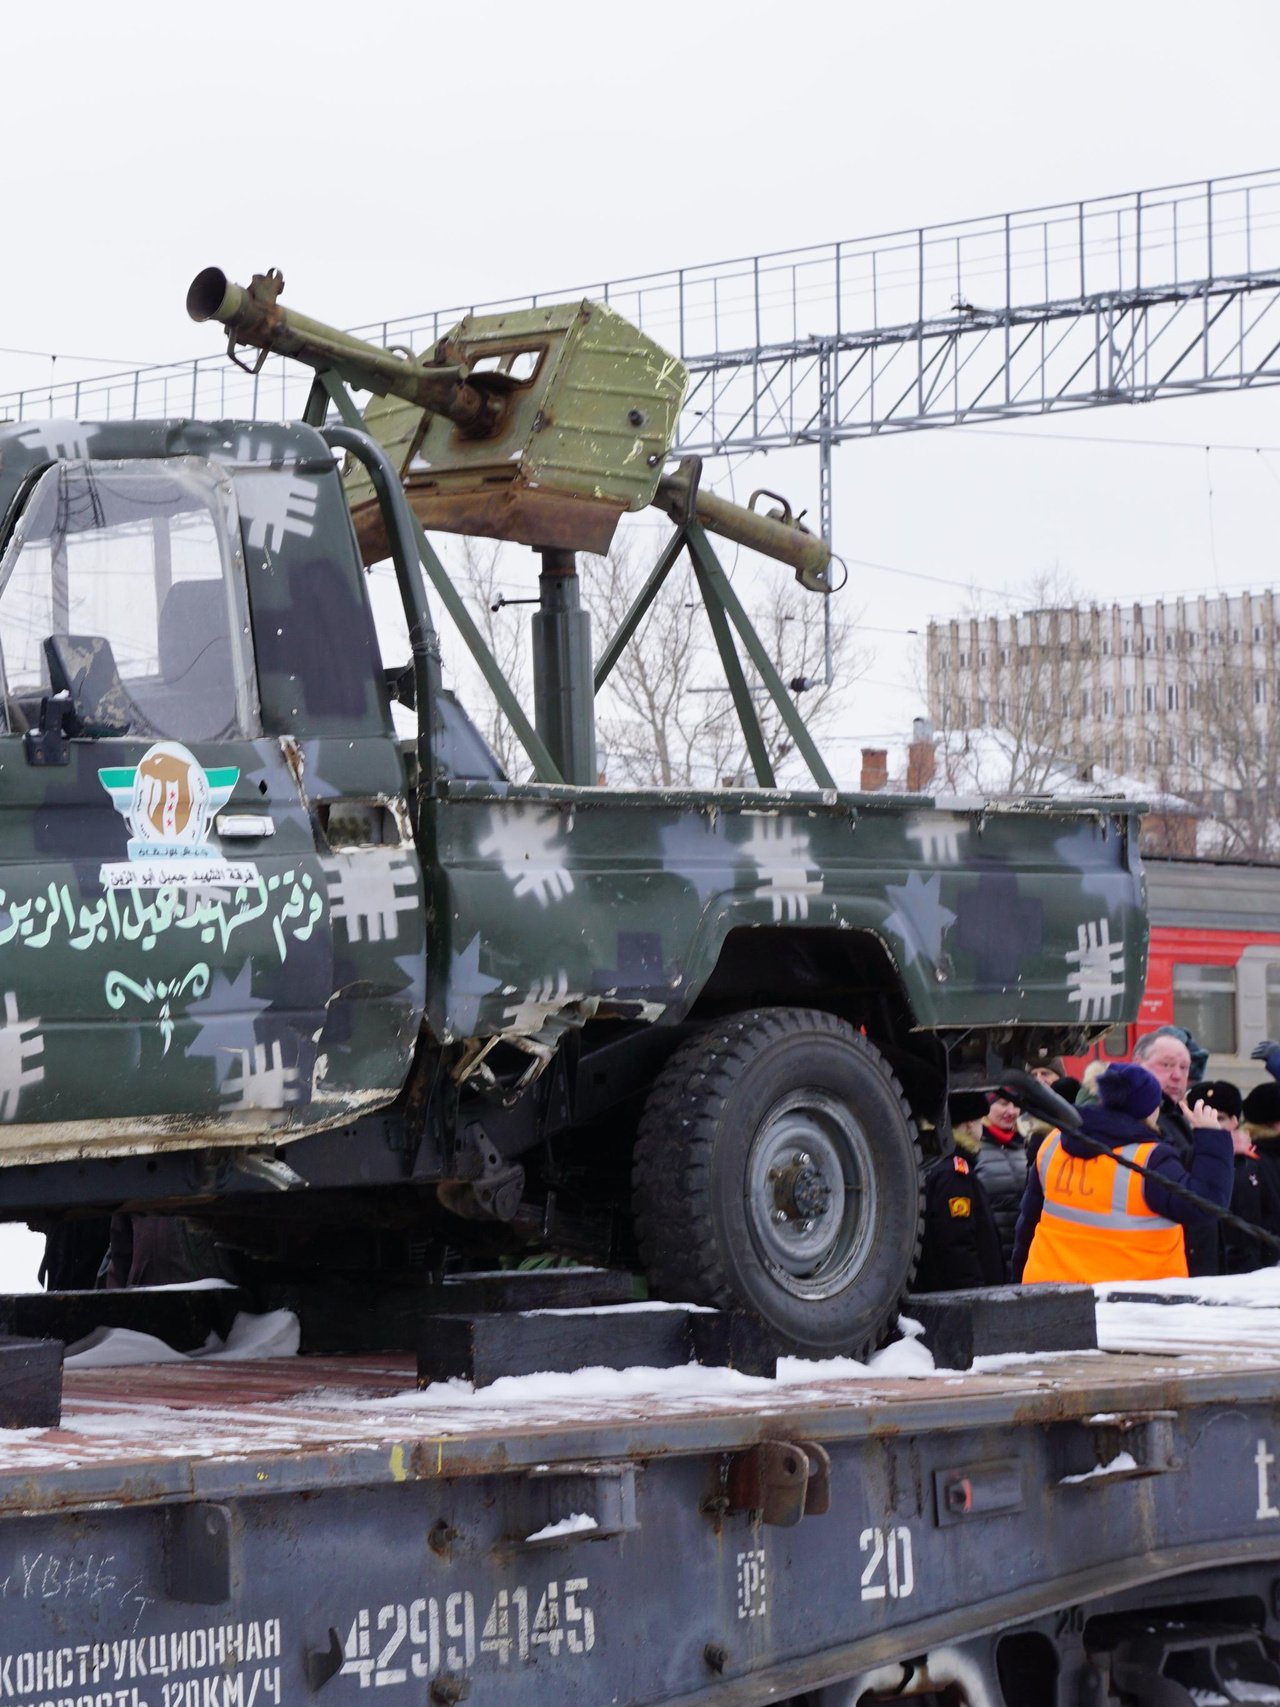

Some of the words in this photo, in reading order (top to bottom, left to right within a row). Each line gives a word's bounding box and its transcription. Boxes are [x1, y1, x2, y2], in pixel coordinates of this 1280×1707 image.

[160, 869, 187, 885] جميل
[192, 869, 225, 884] الشهيد
[226, 868, 254, 884] فرقة
[859, 1526, 914, 1601] 20
[339, 1577, 595, 1689] 42994145
